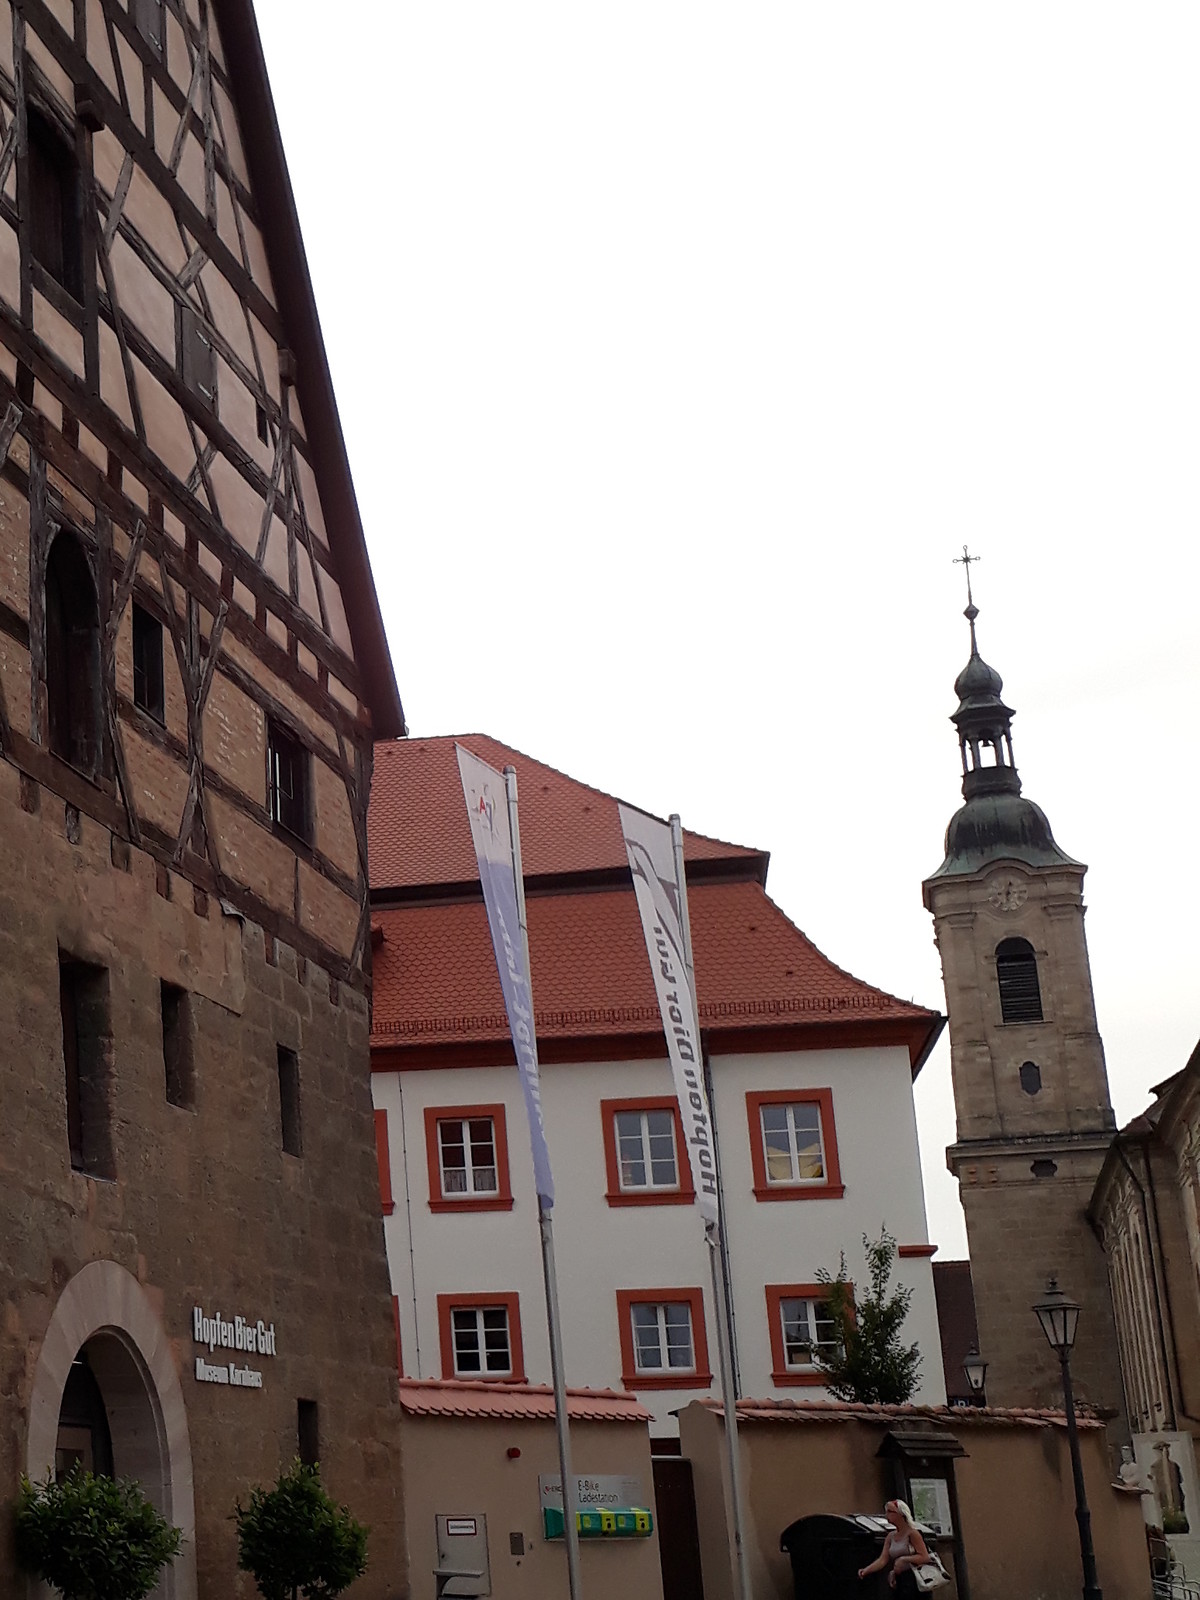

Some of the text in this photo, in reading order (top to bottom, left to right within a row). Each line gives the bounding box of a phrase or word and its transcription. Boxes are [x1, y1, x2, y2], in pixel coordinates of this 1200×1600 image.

[193, 1306, 277, 1356] Hopfen Bier Gut
[578, 1480, 600, 1492] E-Bike
[579, 1492, 619, 1503] Ladestation
